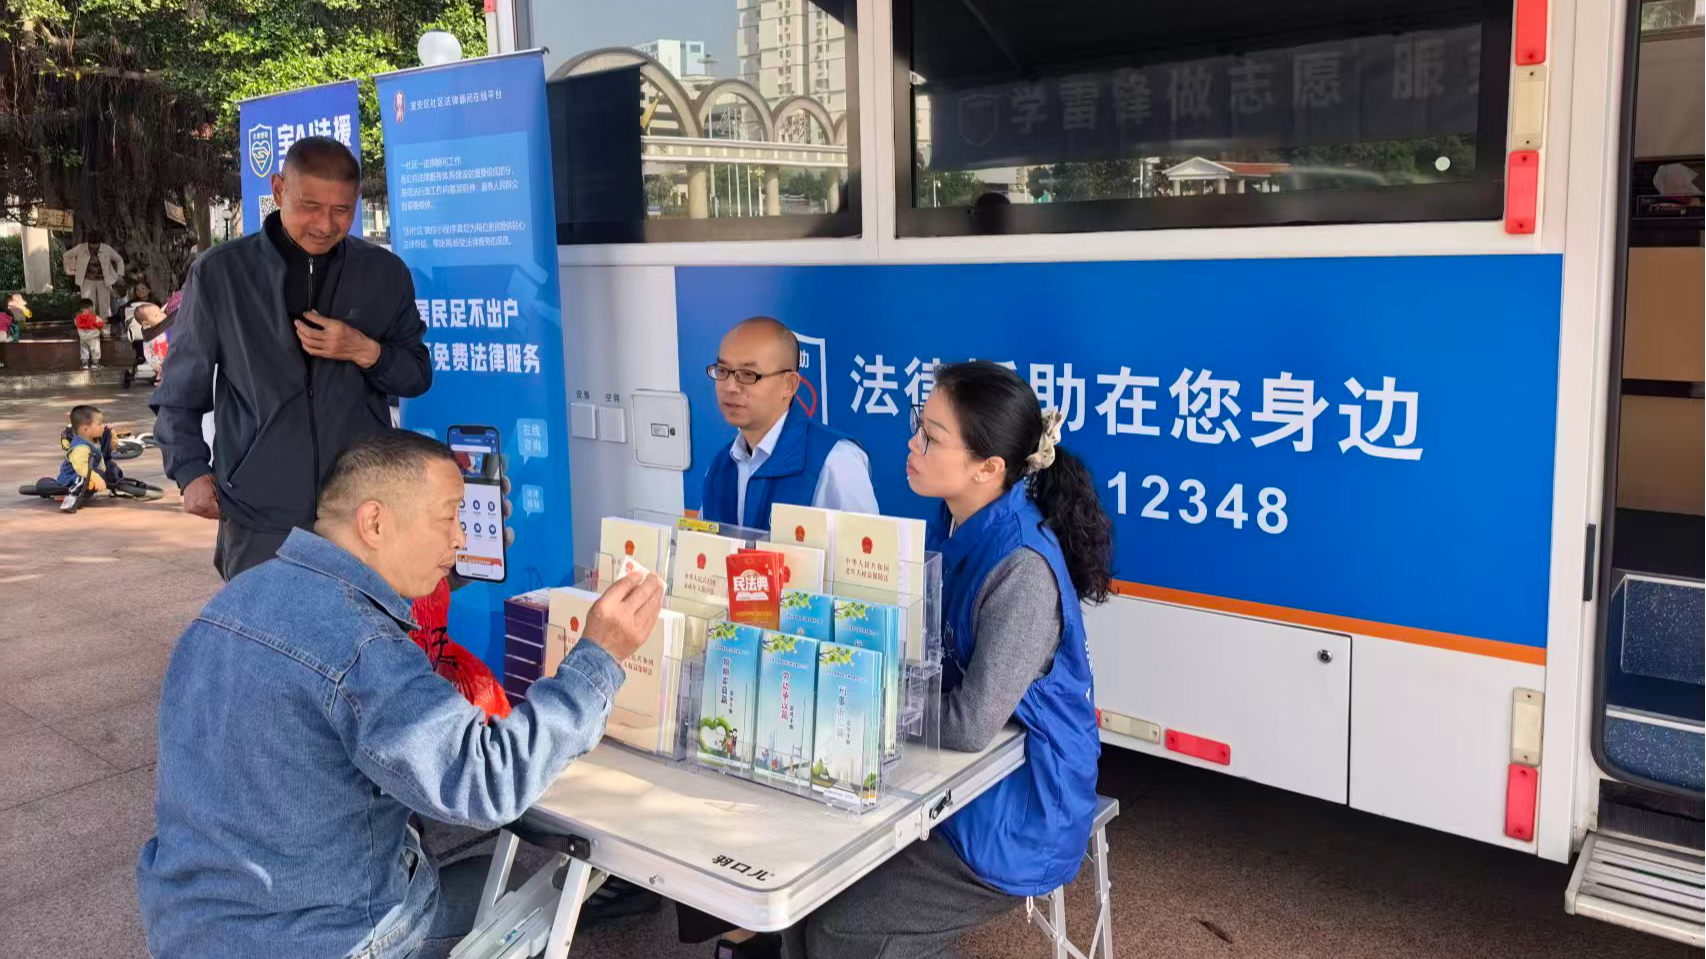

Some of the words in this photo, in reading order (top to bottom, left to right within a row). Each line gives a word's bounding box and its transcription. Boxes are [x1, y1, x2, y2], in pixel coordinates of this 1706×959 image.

[410, 90, 502, 111] 宝安区社区法律顾问在线平台
[424, 342, 540, 374] 免费法律服务
[850, 354, 1424, 461] 法律助在您身边
[1107, 471, 1289, 534] 12348
[733, 576, 770, 592] 民法典
